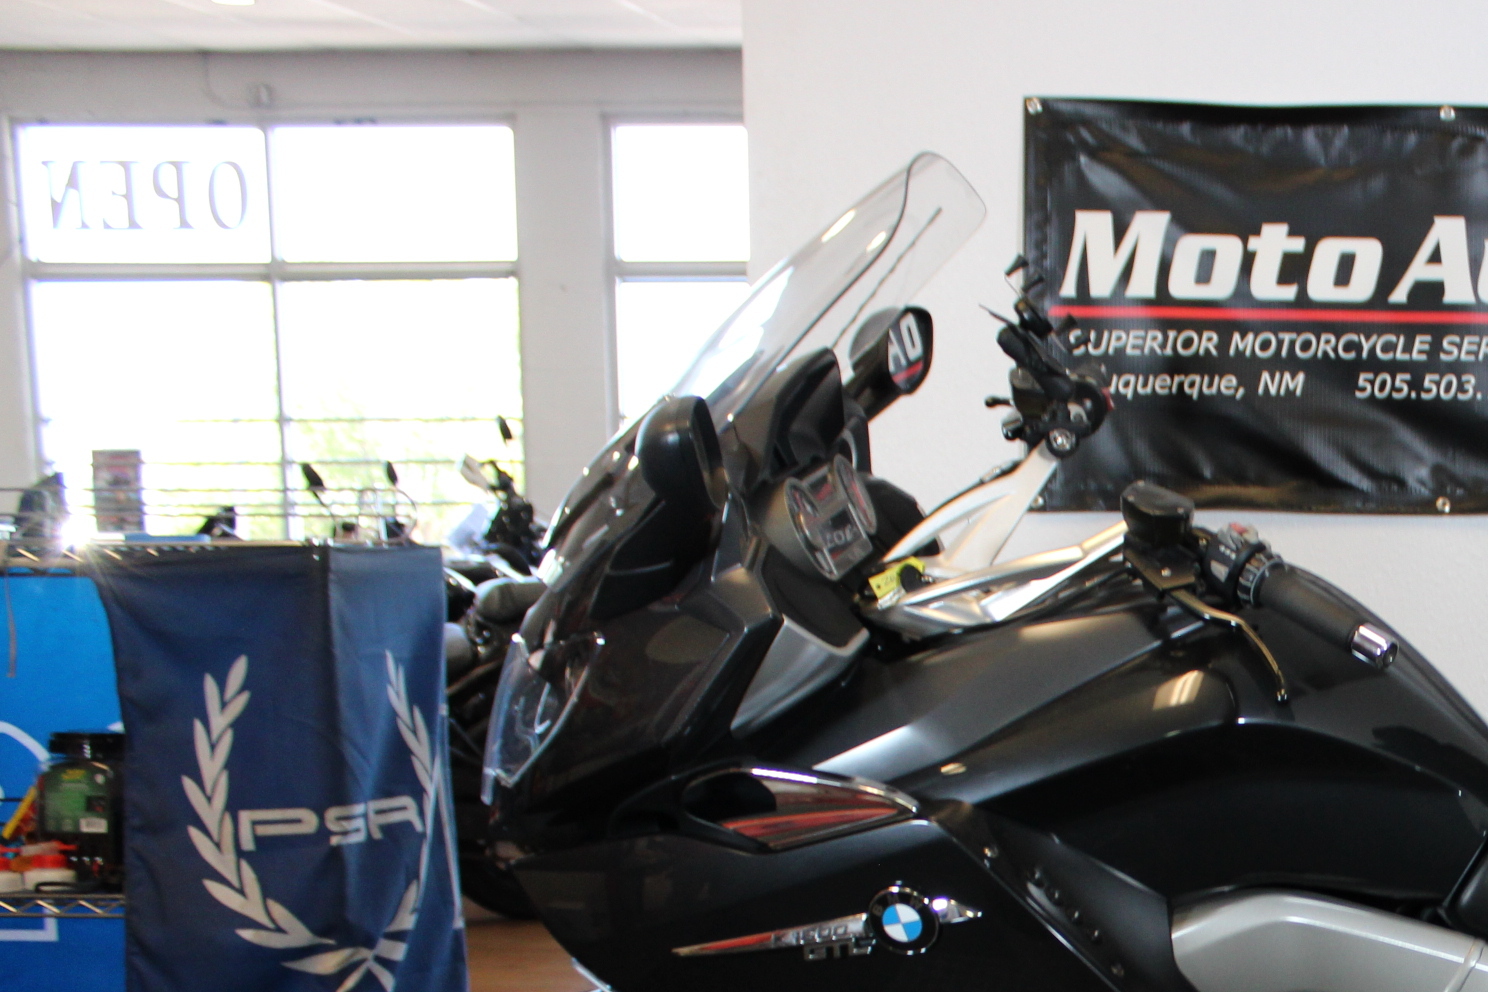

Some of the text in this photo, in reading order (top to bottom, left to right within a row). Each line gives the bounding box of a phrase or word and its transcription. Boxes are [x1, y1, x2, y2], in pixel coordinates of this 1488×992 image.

[1068, 328, 1219, 357] SUPERIOR
[1229, 331, 1432, 362] MOTORCYCLE
[1108, 372, 1245, 400] uquerque,
[1257, 369, 1306, 397] NM
